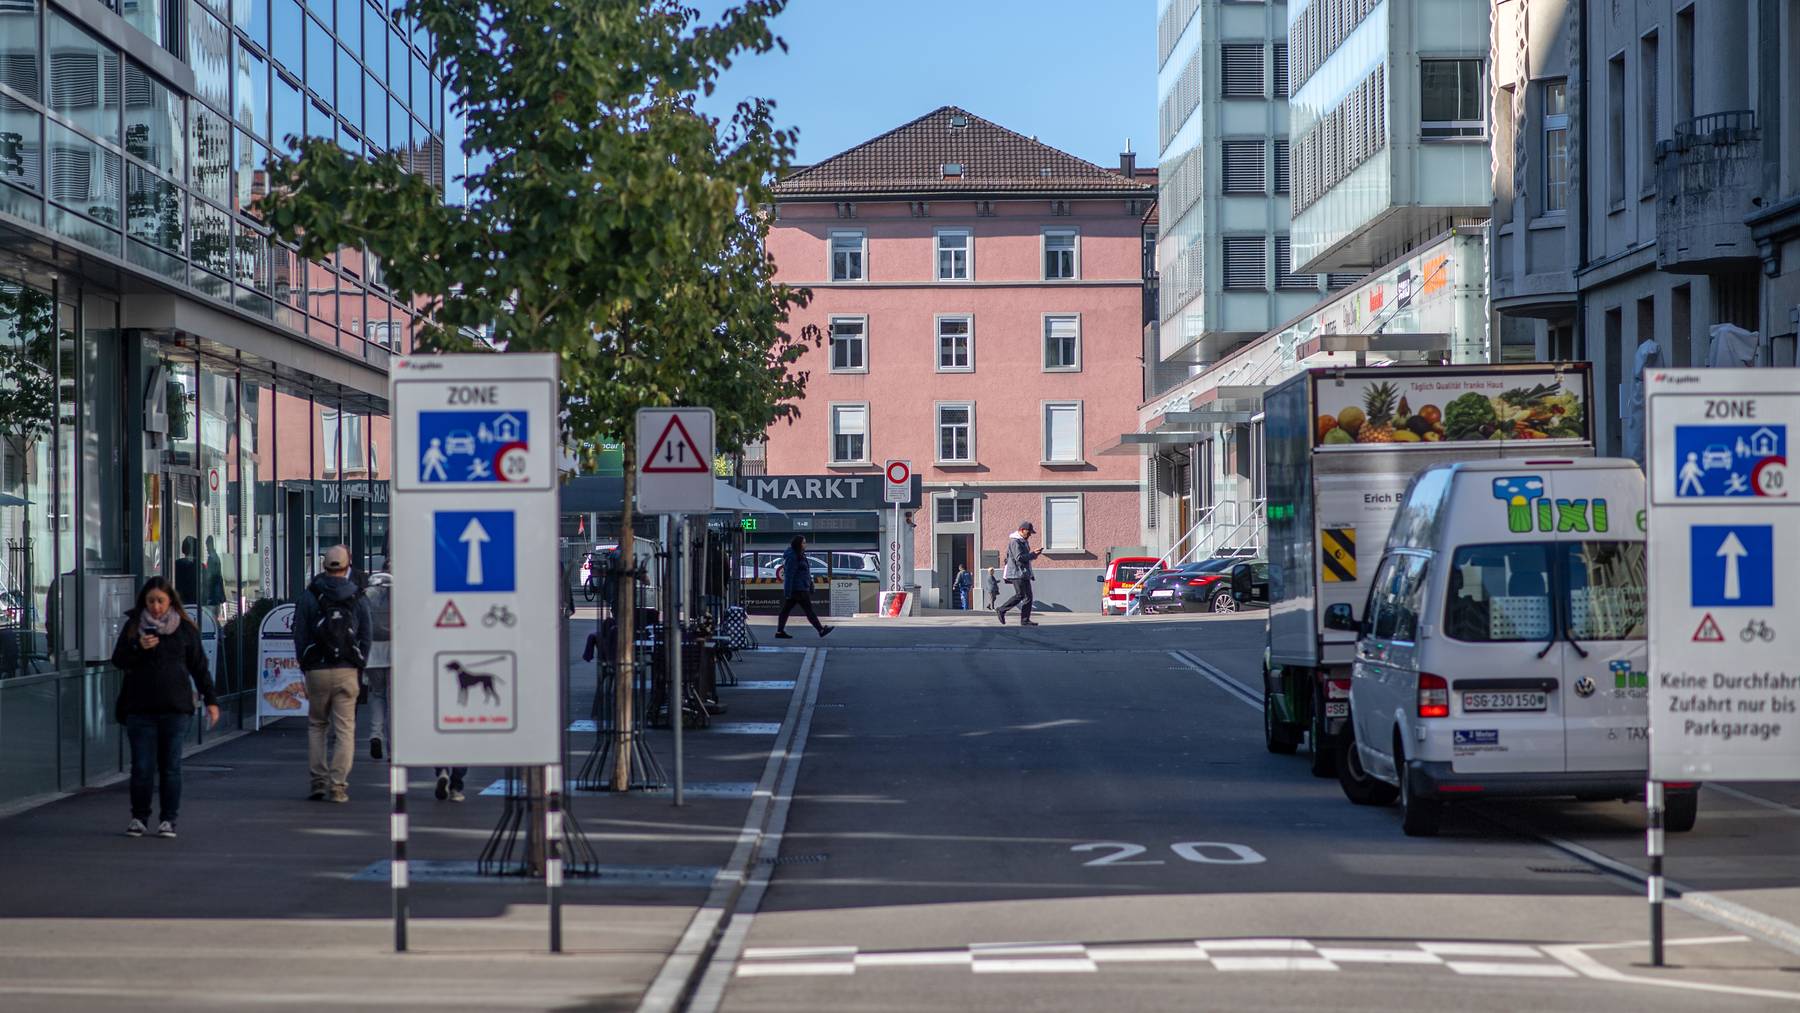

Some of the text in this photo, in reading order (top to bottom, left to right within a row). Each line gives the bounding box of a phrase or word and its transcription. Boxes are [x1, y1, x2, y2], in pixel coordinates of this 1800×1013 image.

[447, 386, 498, 404] ZONE
[1704, 400, 1756, 418] ZONE
[507, 456, 526, 475] 20
[1765, 471, 1784, 489] 20
[1364, 493, 1392, 503] Erich
[1661, 672, 1707, 689] Keine
[1669, 695, 1796, 712] Zufahrt nur bis
[1684, 719, 1781, 741] Parkgarage
[1070, 842, 1267, 866] 20
